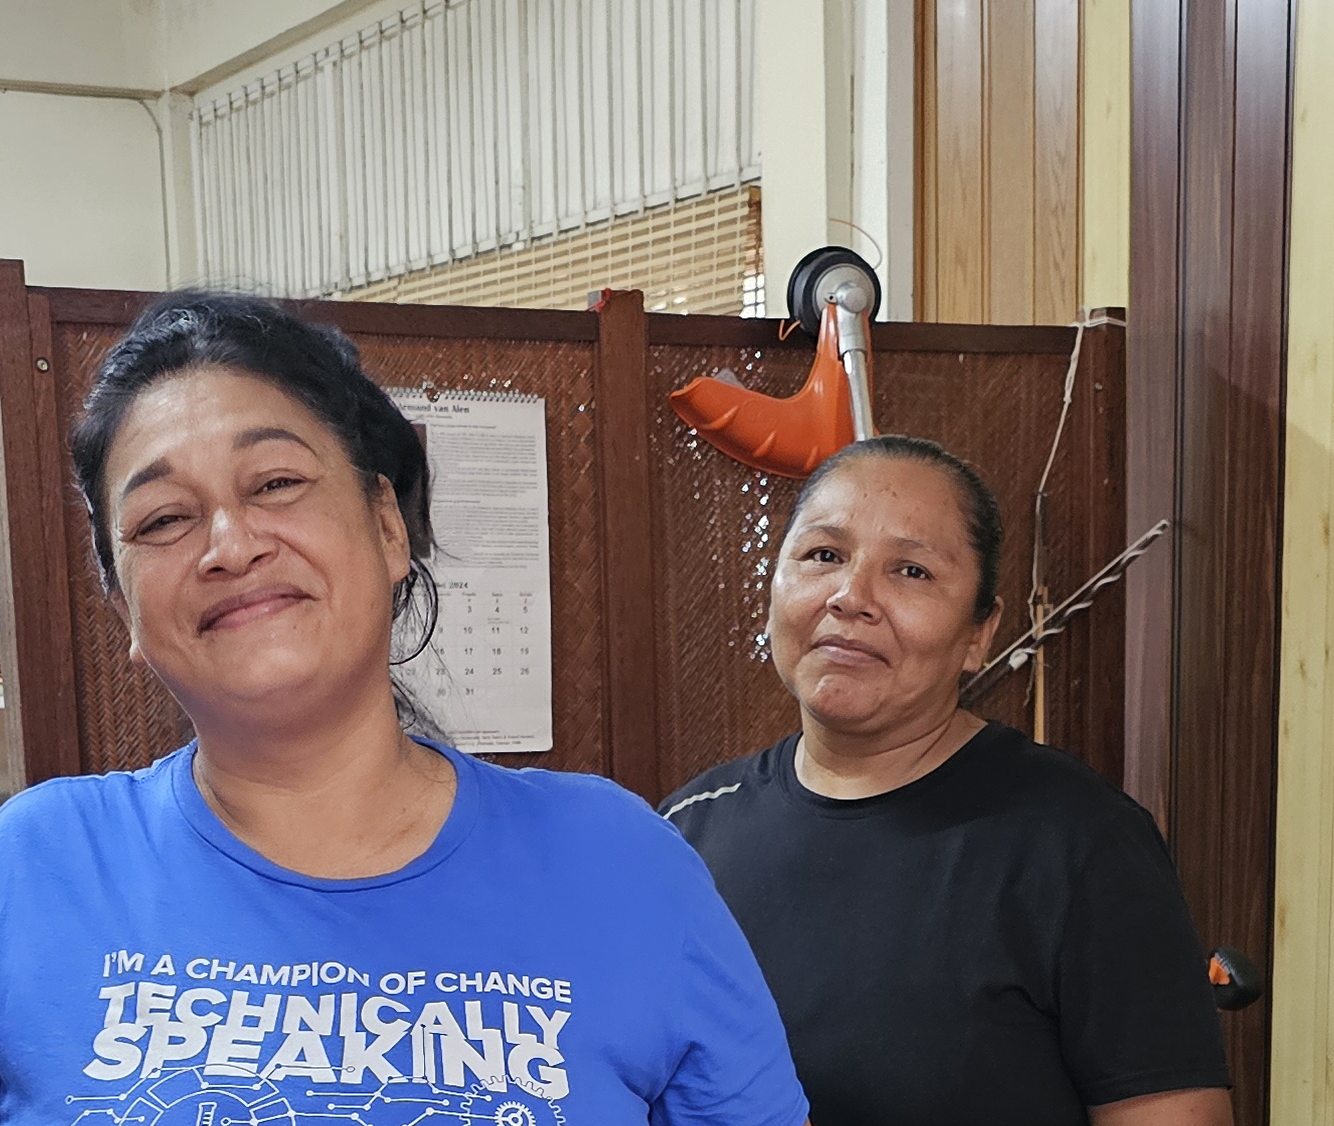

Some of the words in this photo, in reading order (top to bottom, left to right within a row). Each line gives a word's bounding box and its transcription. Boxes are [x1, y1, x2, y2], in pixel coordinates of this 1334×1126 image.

[433, 405, 450, 413] van
[467, 605, 473, 614] 3
[494, 606, 501, 614] 4
[522, 606, 529, 614] 5
[463, 626, 474, 635] 10
[491, 626, 501, 634] 11
[519, 626, 530, 635] 12
[464, 647, 475, 656] 17
[492, 647, 503, 656] 18
[465, 667, 476, 676] 24
[492, 667, 503, 676] 25
[103, 950, 145, 977] I'M
[150, 954, 176, 976] A
[186, 957, 371, 987] CHAMPION
[379, 970, 426, 996] OF
[434, 972, 572, 1003] CHANGE
[98, 980, 571, 1050] TECHNICALLY
[83, 1022, 570, 1099] SPEAKING
